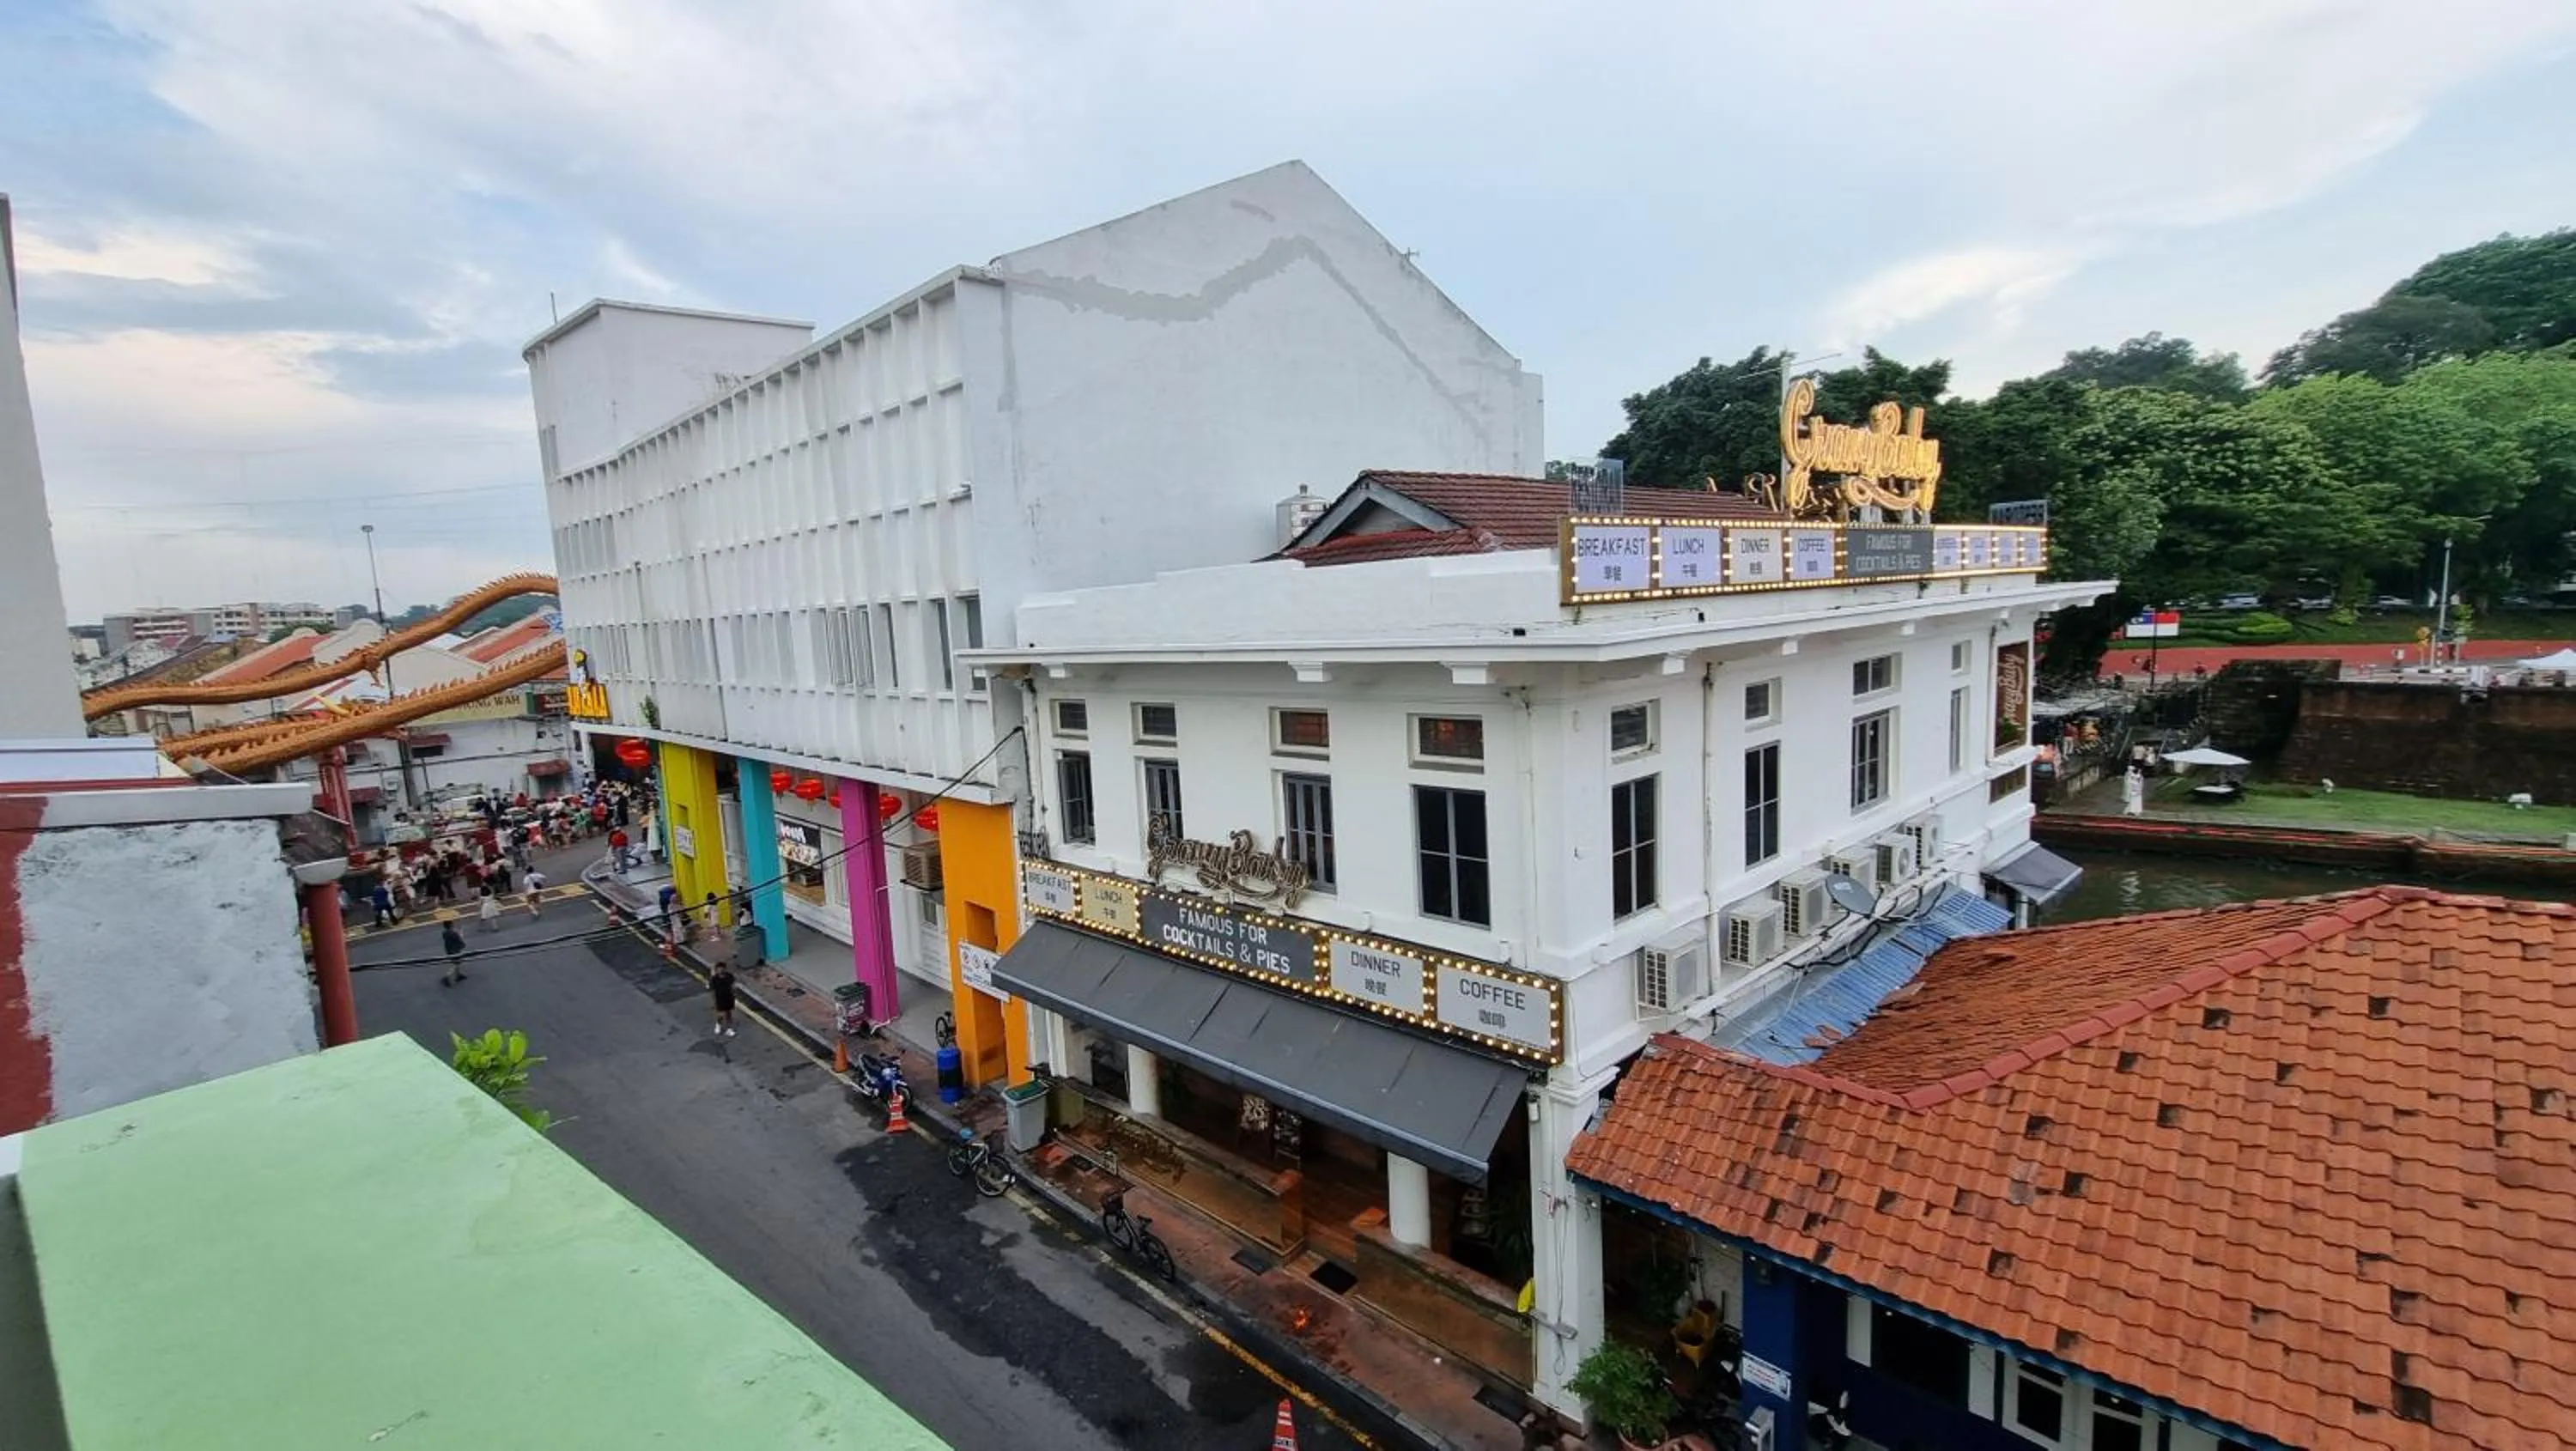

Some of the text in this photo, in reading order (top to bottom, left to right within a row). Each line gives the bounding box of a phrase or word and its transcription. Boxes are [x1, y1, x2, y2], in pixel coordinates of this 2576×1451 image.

[1577, 537, 1646, 557] BREAKFAST
[1672, 538, 1704, 555] LUNCH
[1741, 537, 1770, 554] DINNER
[1798, 537, 1826, 552] COFFEE
[1095, 889, 1122, 903] LUNCH
[1178, 908, 1267, 945] FAMOUS FOR
[1163, 924, 1291, 974] COCKTAILS & PIES
[1351, 950, 1400, 977] DINNER
[1460, 979, 1526, 1011] COFFEE
